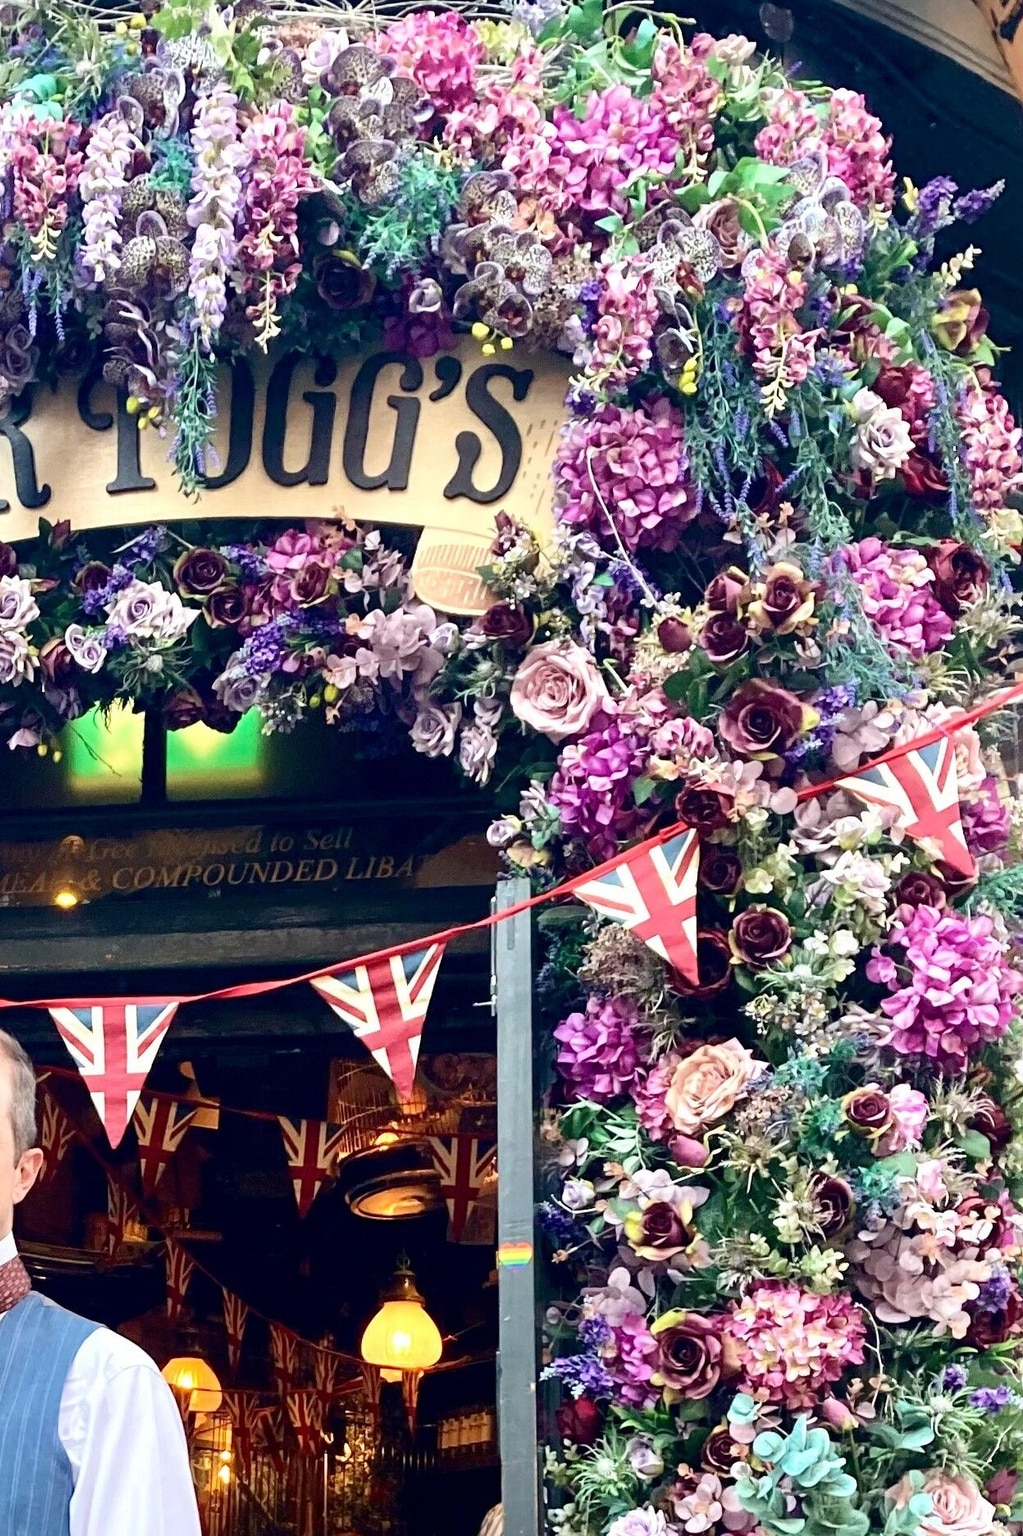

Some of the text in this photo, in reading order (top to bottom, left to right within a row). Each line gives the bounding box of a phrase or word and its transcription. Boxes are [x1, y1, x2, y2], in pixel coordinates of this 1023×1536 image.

[270, 833, 294, 852] to
[303, 826, 354, 851] Sell
[111, 857, 339, 891] COMPOUNDED
